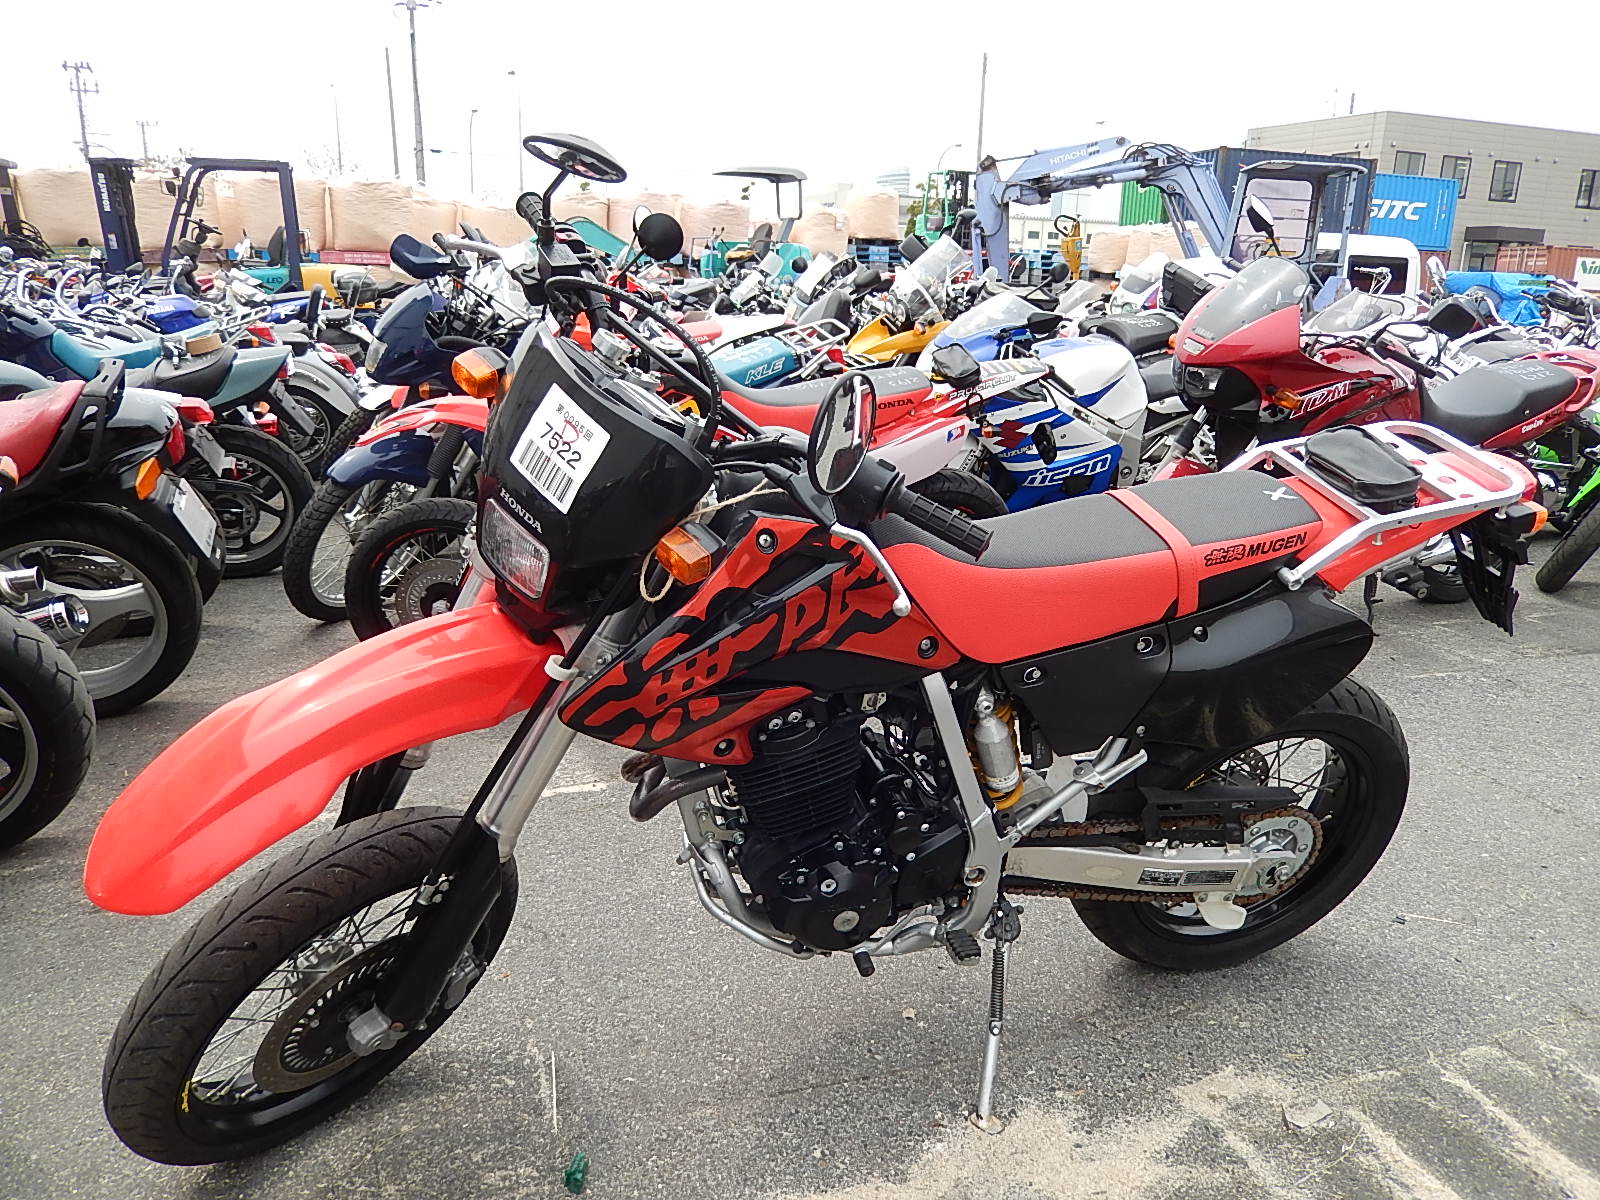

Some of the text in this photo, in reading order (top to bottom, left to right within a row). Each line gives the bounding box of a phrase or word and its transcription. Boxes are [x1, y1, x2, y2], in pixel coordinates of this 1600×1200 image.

[1049, 149, 1087, 165] HITACHI
[97, 172, 111, 212] KOMATSU
[1369, 198, 1428, 221] SITC
[744, 356, 786, 385] KLE
[876, 398, 914, 411] ONDA
[1289, 379, 1352, 420] TDM
[540, 421, 582, 471] 7522
[500, 487, 542, 534] HONDA
[1246, 532, 1308, 558] MUGEN
